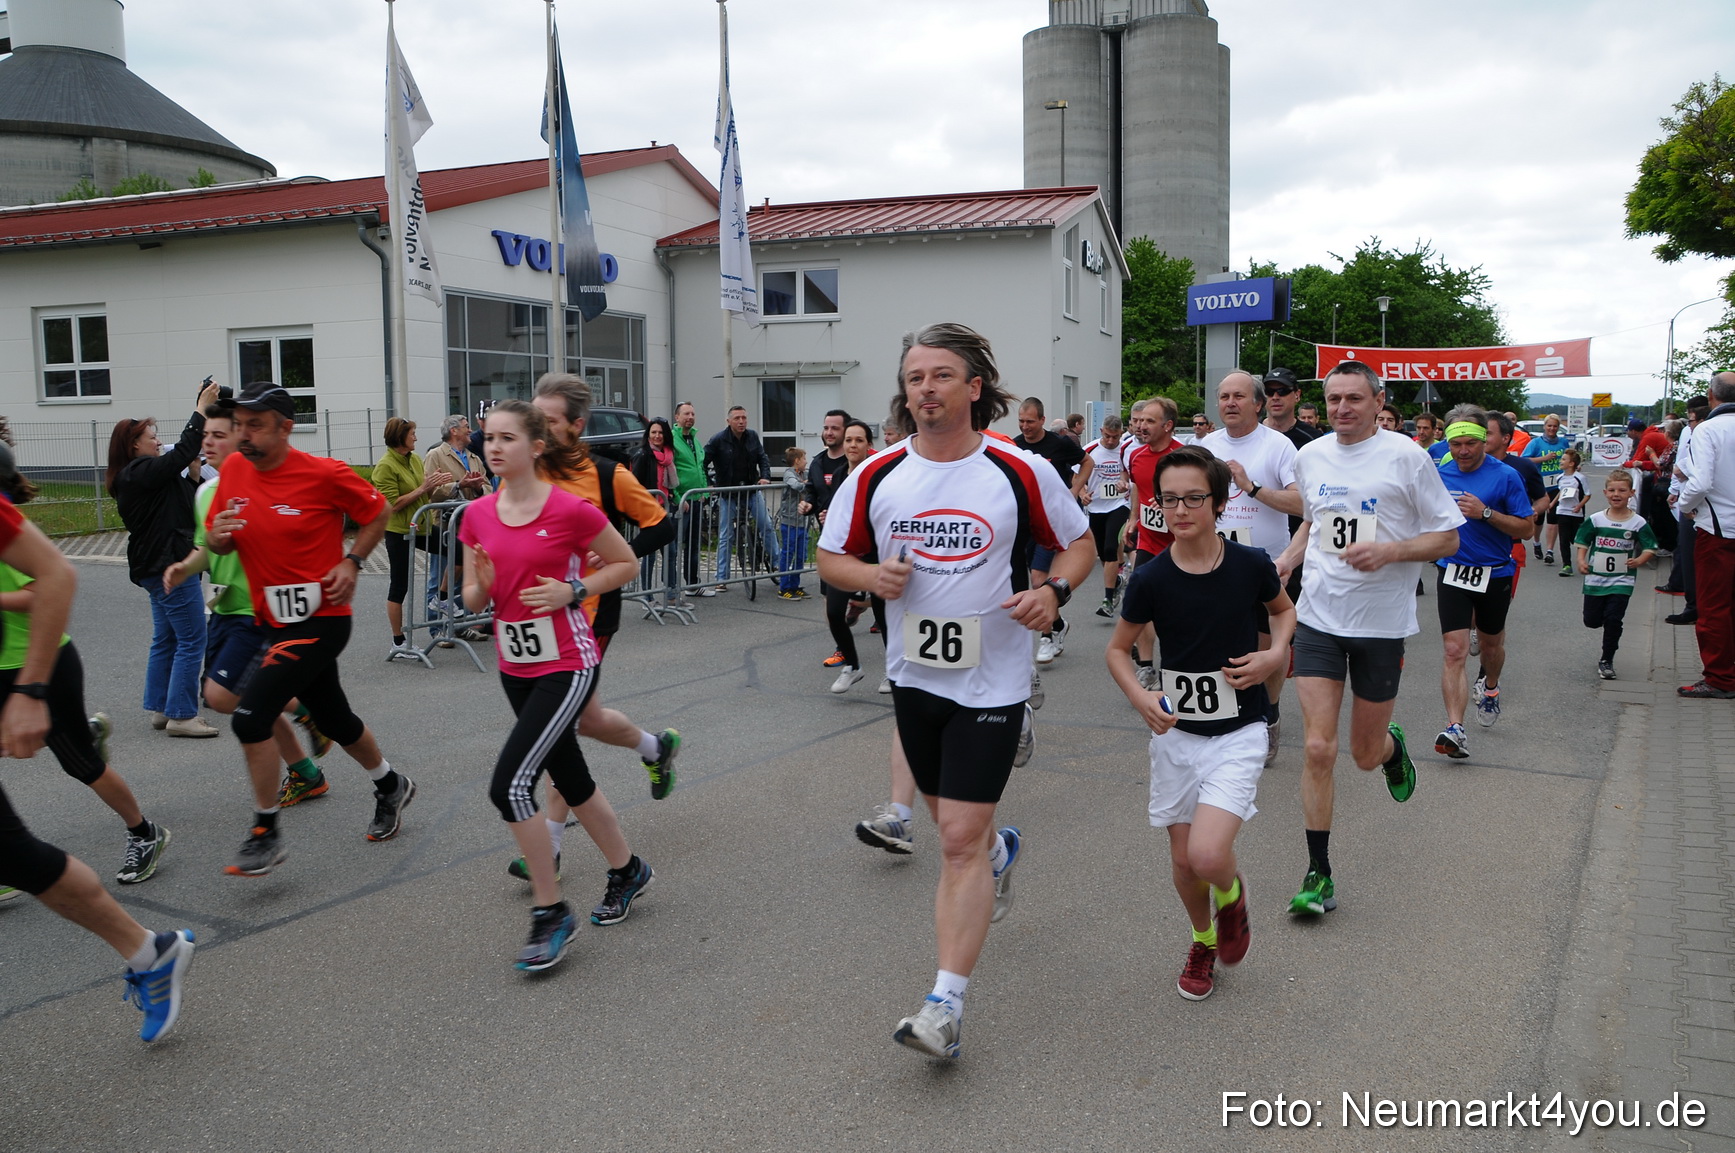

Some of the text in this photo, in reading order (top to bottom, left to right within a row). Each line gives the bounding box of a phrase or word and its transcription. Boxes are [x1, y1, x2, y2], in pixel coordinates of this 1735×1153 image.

[491, 230, 618, 283] VOO
[1194, 291, 1260, 311] VOLVO
[1562, 488, 1568, 497] 2
[890, 520, 972, 535] GERHART
[1144, 507, 1164, 528] 123
[1332, 516, 1358, 549] 31
[1452, 563, 1484, 588] 148
[1606, 556, 1616, 573] 6
[274, 586, 309, 618] 115
[505, 621, 542, 658] 35
[919, 619, 963, 663] 26
[1175, 675, 1220, 715] 28
